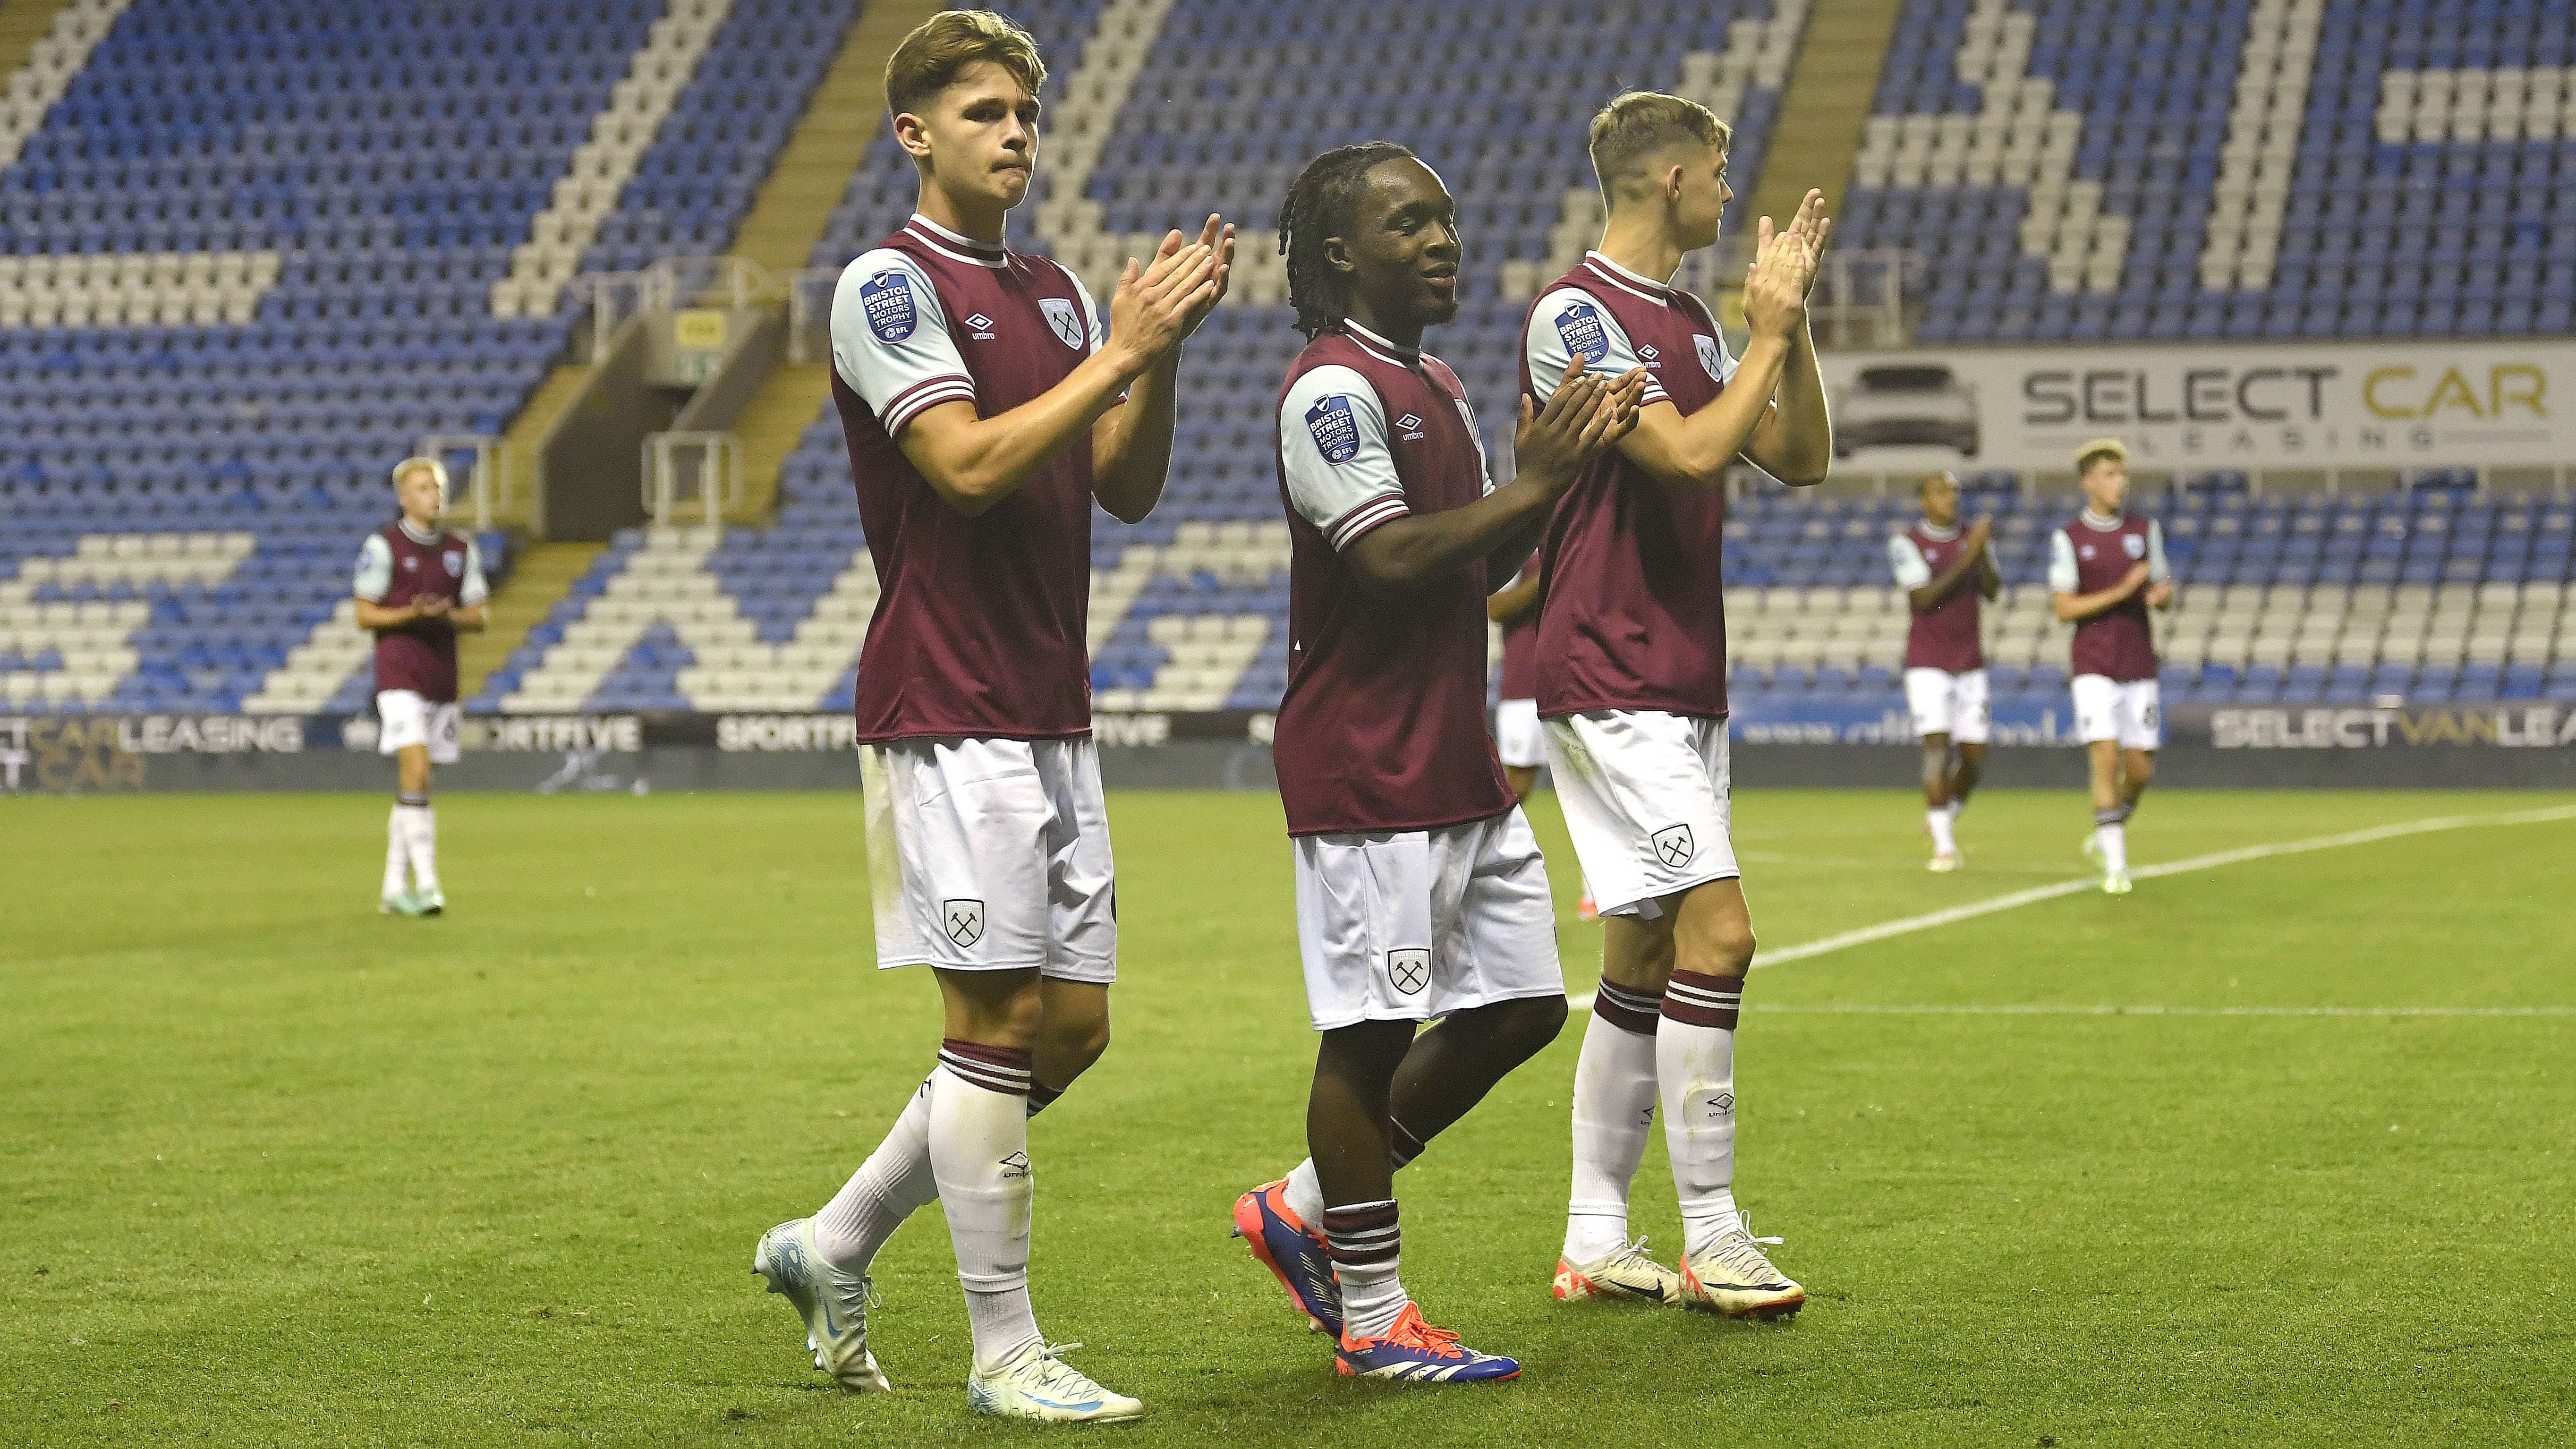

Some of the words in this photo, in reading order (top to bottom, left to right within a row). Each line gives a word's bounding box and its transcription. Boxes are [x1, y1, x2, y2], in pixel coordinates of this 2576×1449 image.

[863, 286, 909, 306] BRISTOL
[868, 295, 909, 314] STREET
[872, 304, 910, 321] MOTORS
[875, 312, 910, 328] TROPHY
[896, 326, 909, 334] EFL
[1559, 315, 1598, 335] BRISTOL
[1564, 322, 1599, 342] STREET
[972, 331, 995, 341] umbro
[1568, 330, 1601, 347] MOTORS
[1572, 336, 1602, 353] TROPHY
[2023, 367, 2340, 426] SELECT
[2361, 363, 2550, 419] CAR
[1309, 408, 1351, 432] BRISTOL
[1315, 417, 1351, 439] STREET
[1319, 425, 1353, 445] MOTORS
[1322, 432, 1354, 451] TROPHY
[1403, 430, 1424, 441] umbro
[2139, 427, 2433, 455] LEASING
[1341, 447, 1354, 455] EFL
